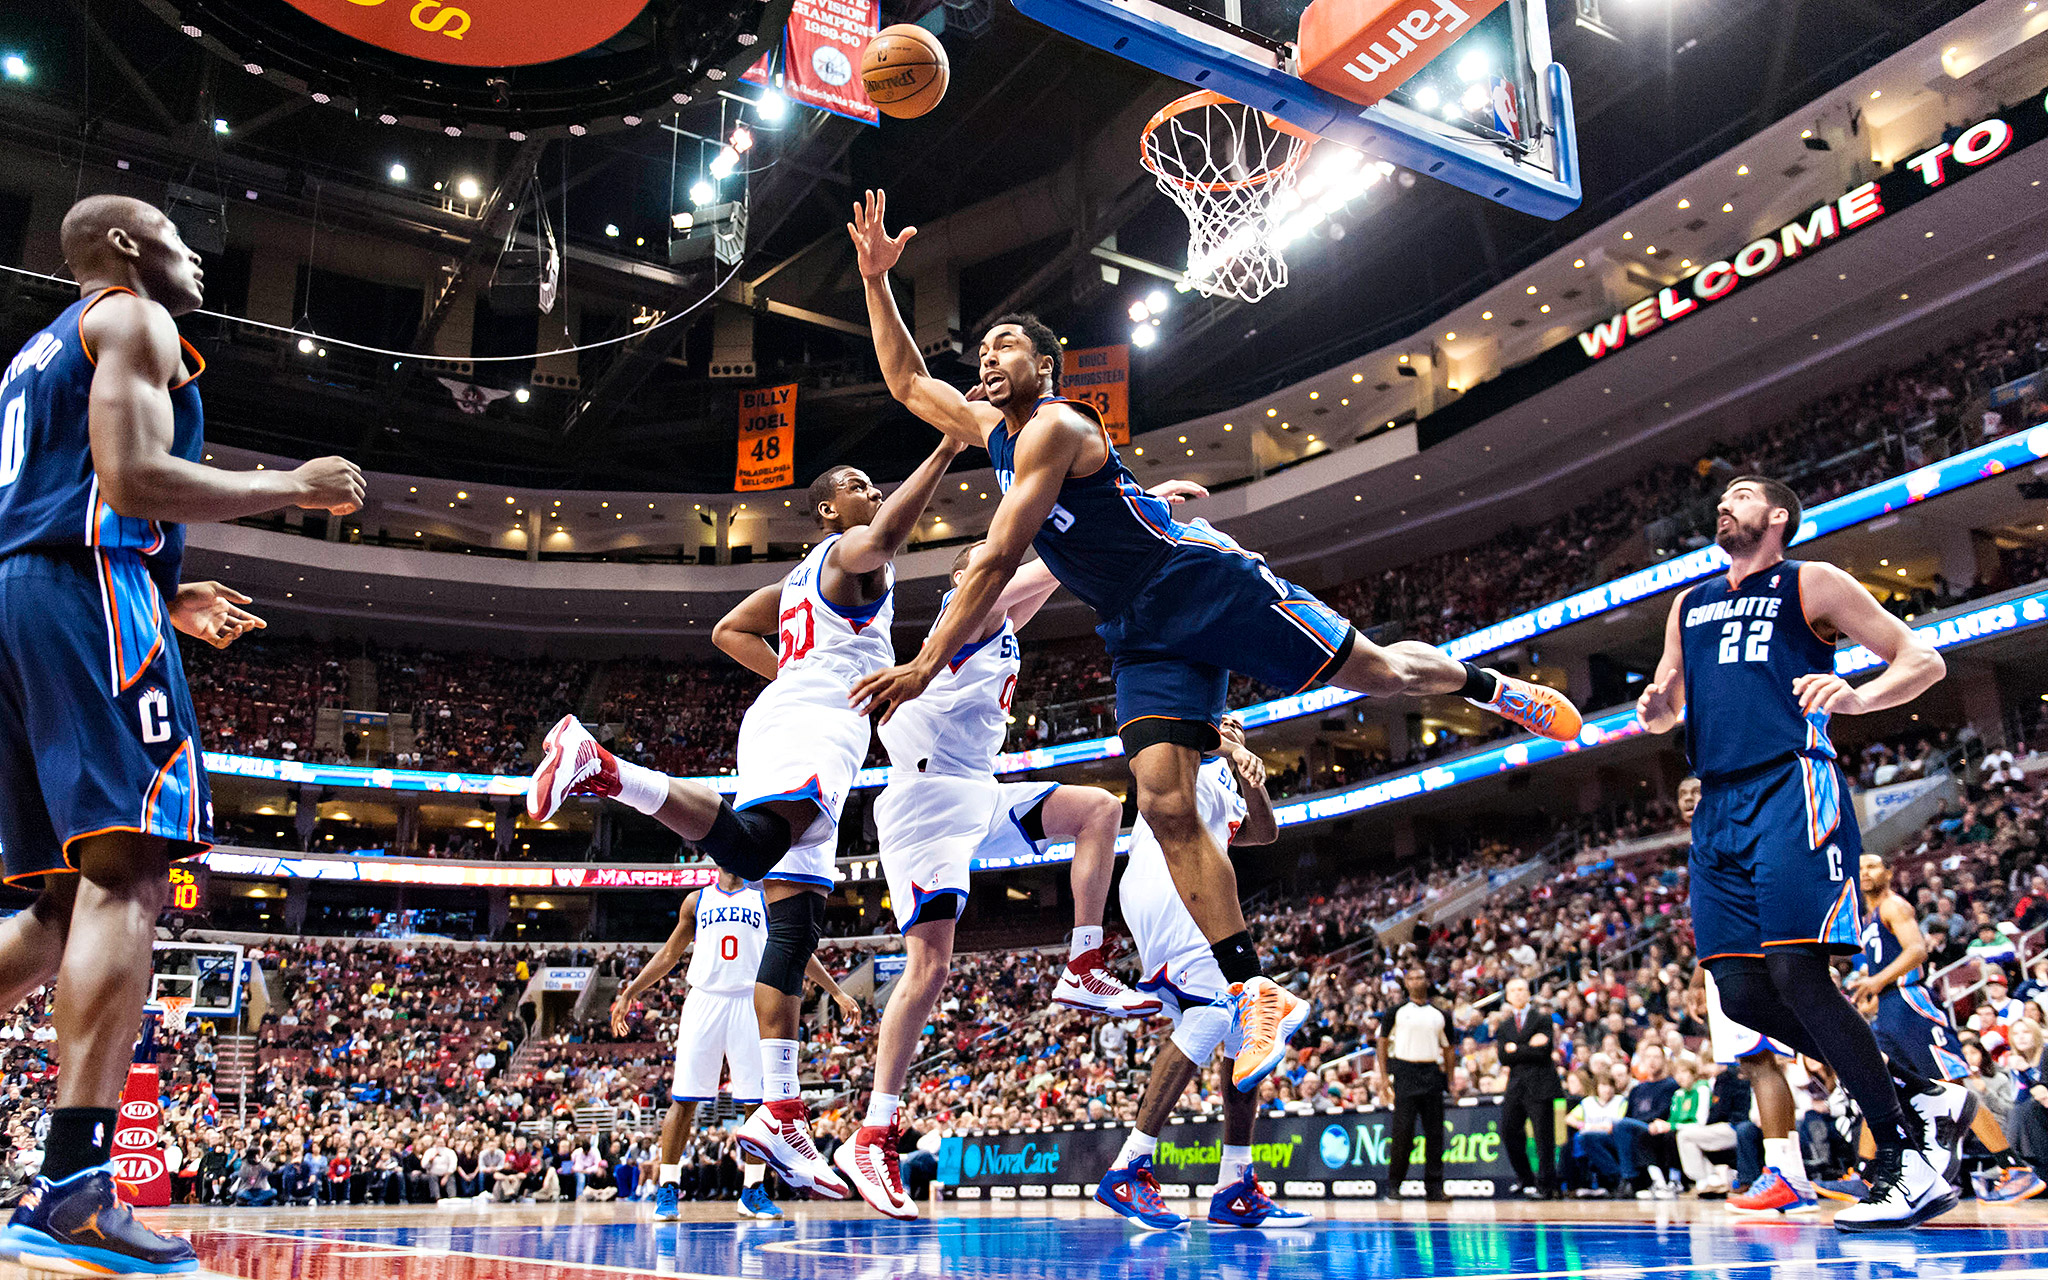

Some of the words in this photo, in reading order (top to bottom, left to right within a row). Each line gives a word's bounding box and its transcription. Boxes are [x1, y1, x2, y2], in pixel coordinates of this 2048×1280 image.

[804, 19, 861, 48] 1989-90
[1343, 0, 1471, 82] Farm
[1577, 180, 1885, 360] WELCOME
[1906, 117, 2014, 187] TO
[743, 389, 790, 408] BILLY
[745, 413, 789, 432] JOEL
[751, 436, 780, 462] 48
[1537, 602, 1566, 630] OF
[1685, 596, 1783, 628] CHARLOTTE
[1912, 604, 2017, 649] RANKS
[1718, 619, 1774, 664] 22
[174, 884, 199, 910] 10
[700, 905, 762, 930] SIXERS
[721, 935, 739, 961] 0
[550, 971, 586, 979] GEICO
[127, 1104, 152, 1116] KIA
[121, 1132, 151, 1145] KIA
[1160, 1138, 1221, 1171] Physical
[113, 1160, 153, 1178] KIA
